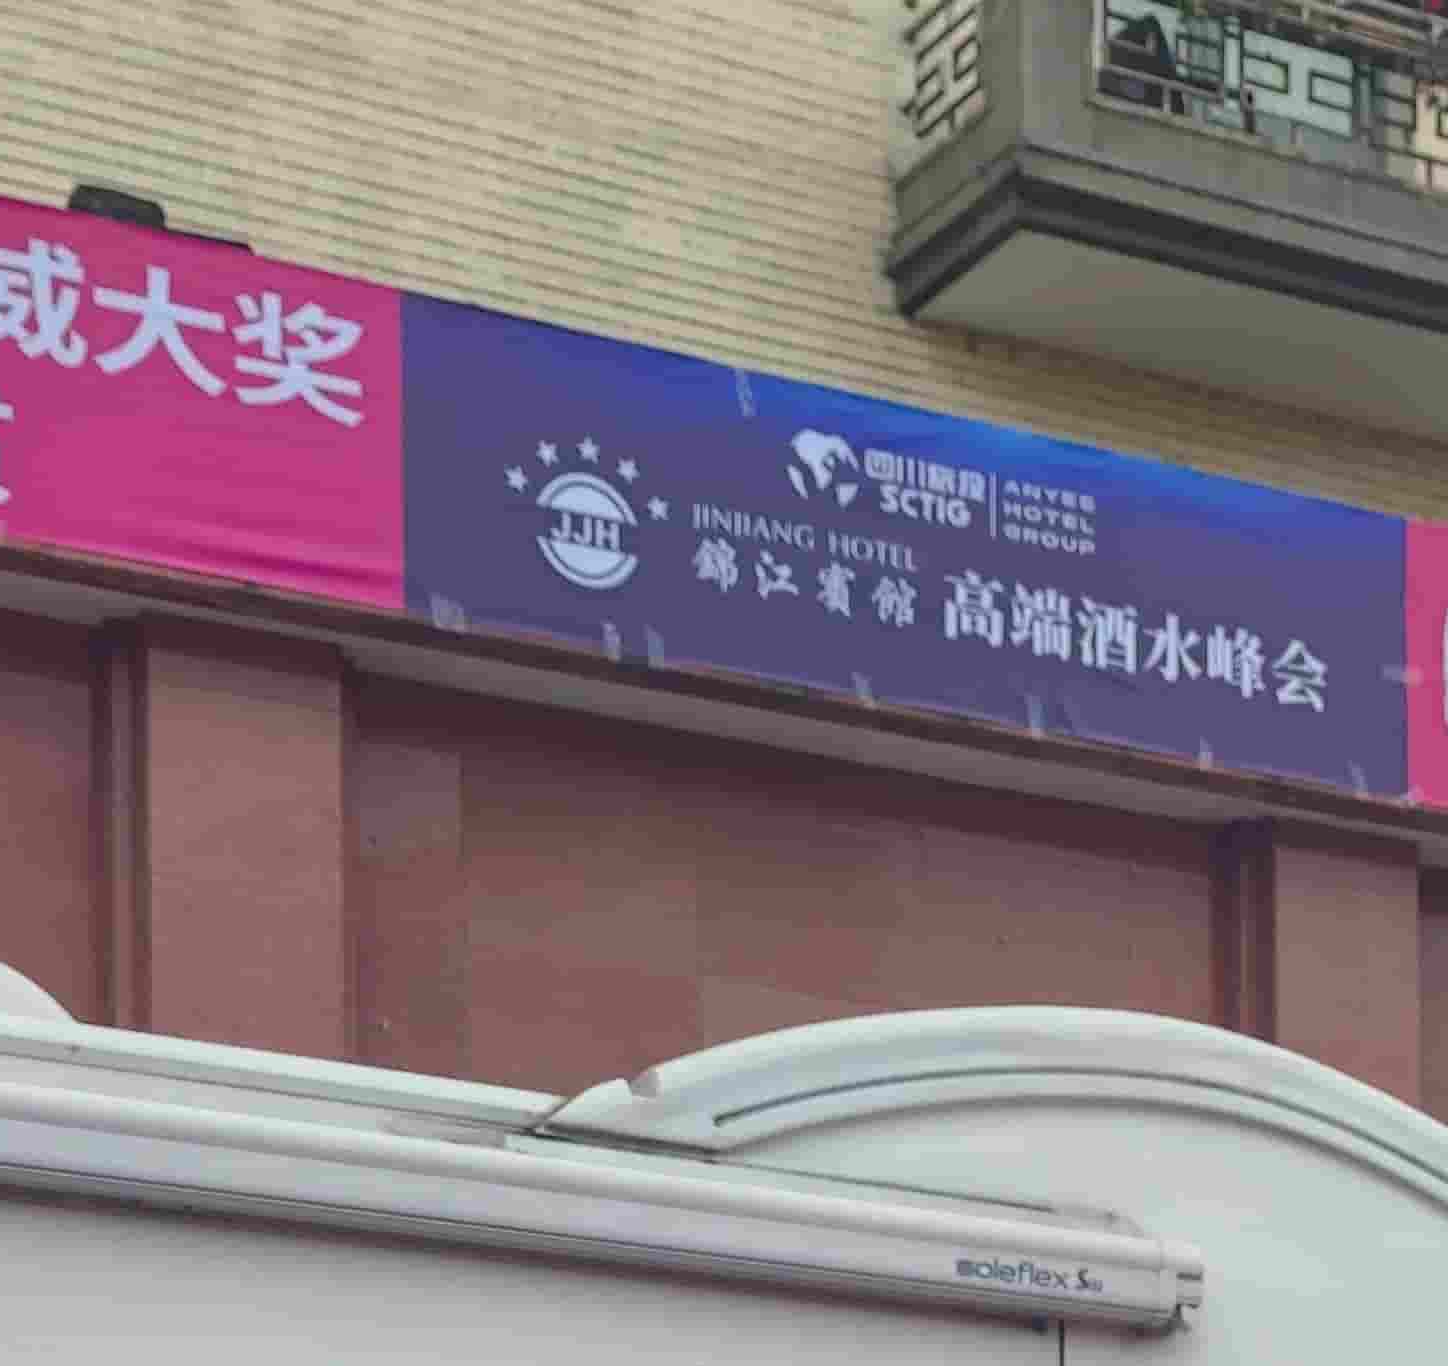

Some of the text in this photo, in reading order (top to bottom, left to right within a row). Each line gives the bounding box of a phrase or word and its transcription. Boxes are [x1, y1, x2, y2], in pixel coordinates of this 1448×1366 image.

[879, 484, 972, 528] SCTIG
[1002, 500, 1096, 535] HOTEL
[551, 512, 622, 553] JJH
[692, 503, 921, 573] JINJIANG HOTEL
[1002, 522, 1096, 556] GROUP
[943, 568, 1329, 713] 高端酒水峰会
